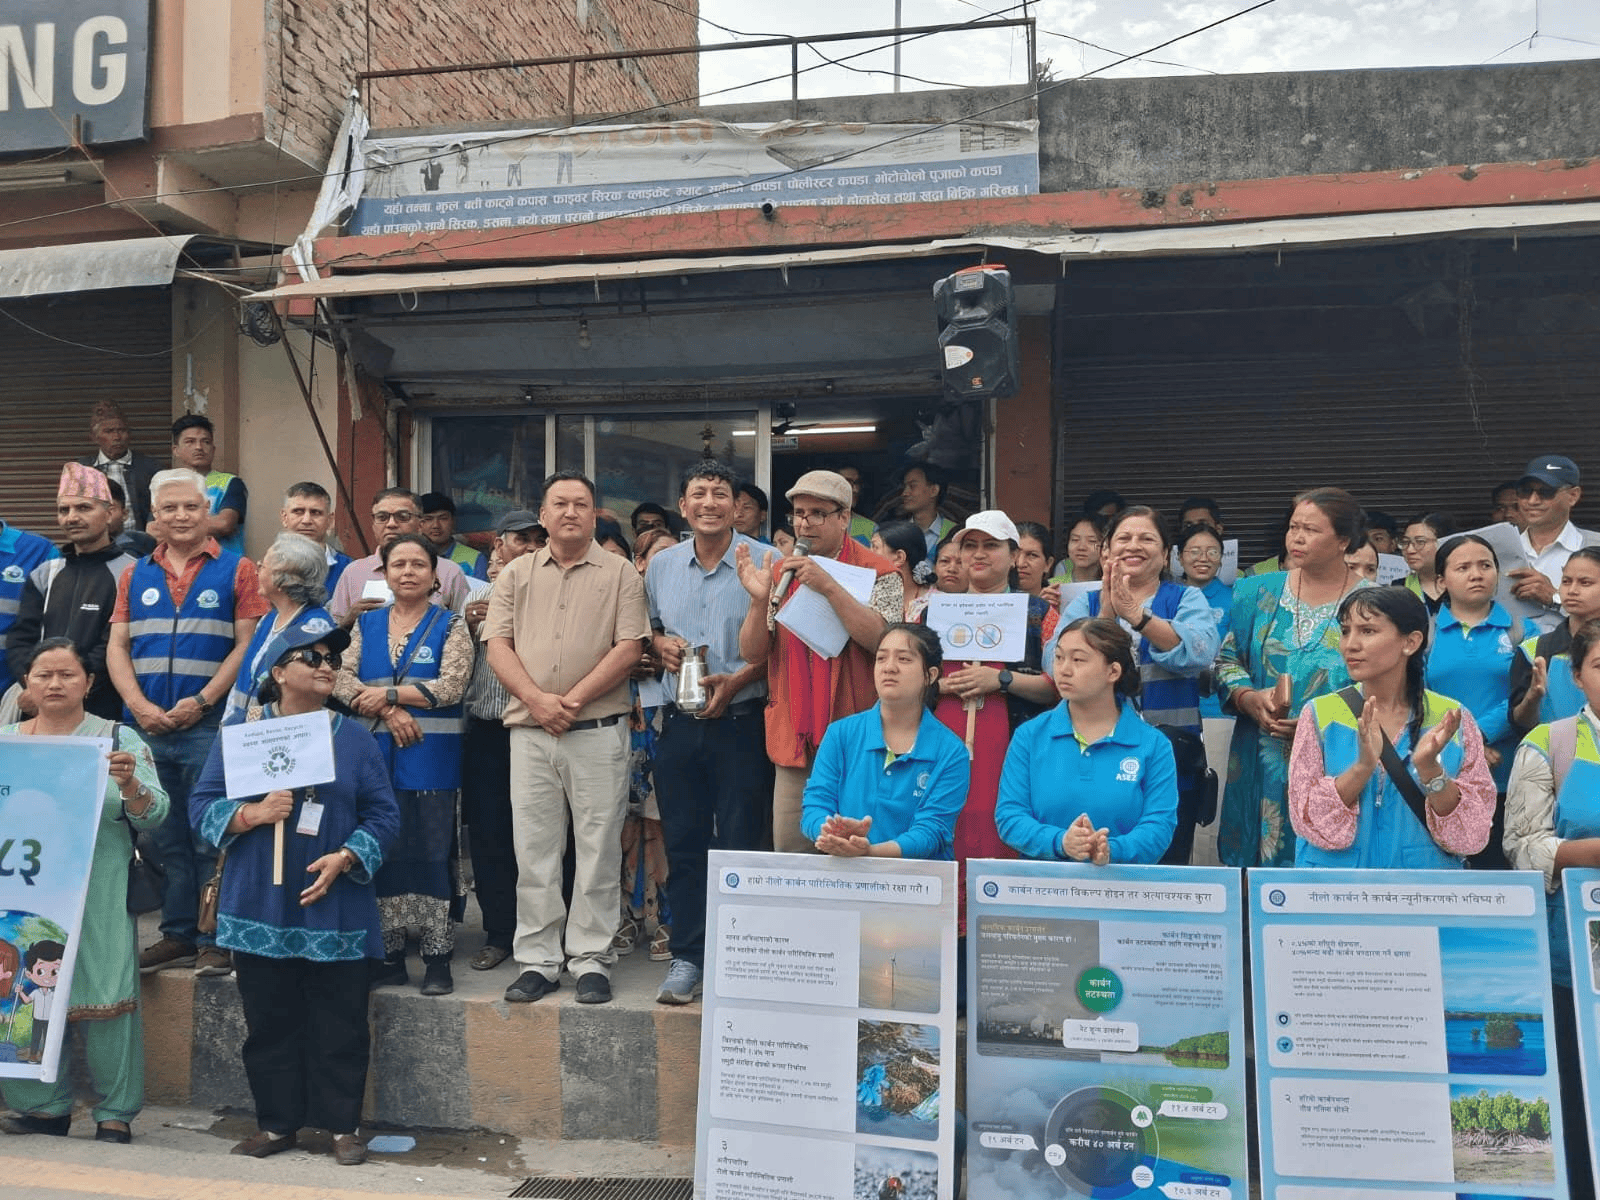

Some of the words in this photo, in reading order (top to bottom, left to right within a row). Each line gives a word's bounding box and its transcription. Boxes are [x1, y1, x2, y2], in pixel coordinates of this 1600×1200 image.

[765, 875, 782, 887] नीलो
[785, 876, 807, 888] कार्बन
[1008, 884, 1033, 895] कार्बन
[1308, 890, 1330, 902] नीलो
[1333, 892, 1360, 903] कार्बन
[1371, 892, 1398, 904] कार्बन
